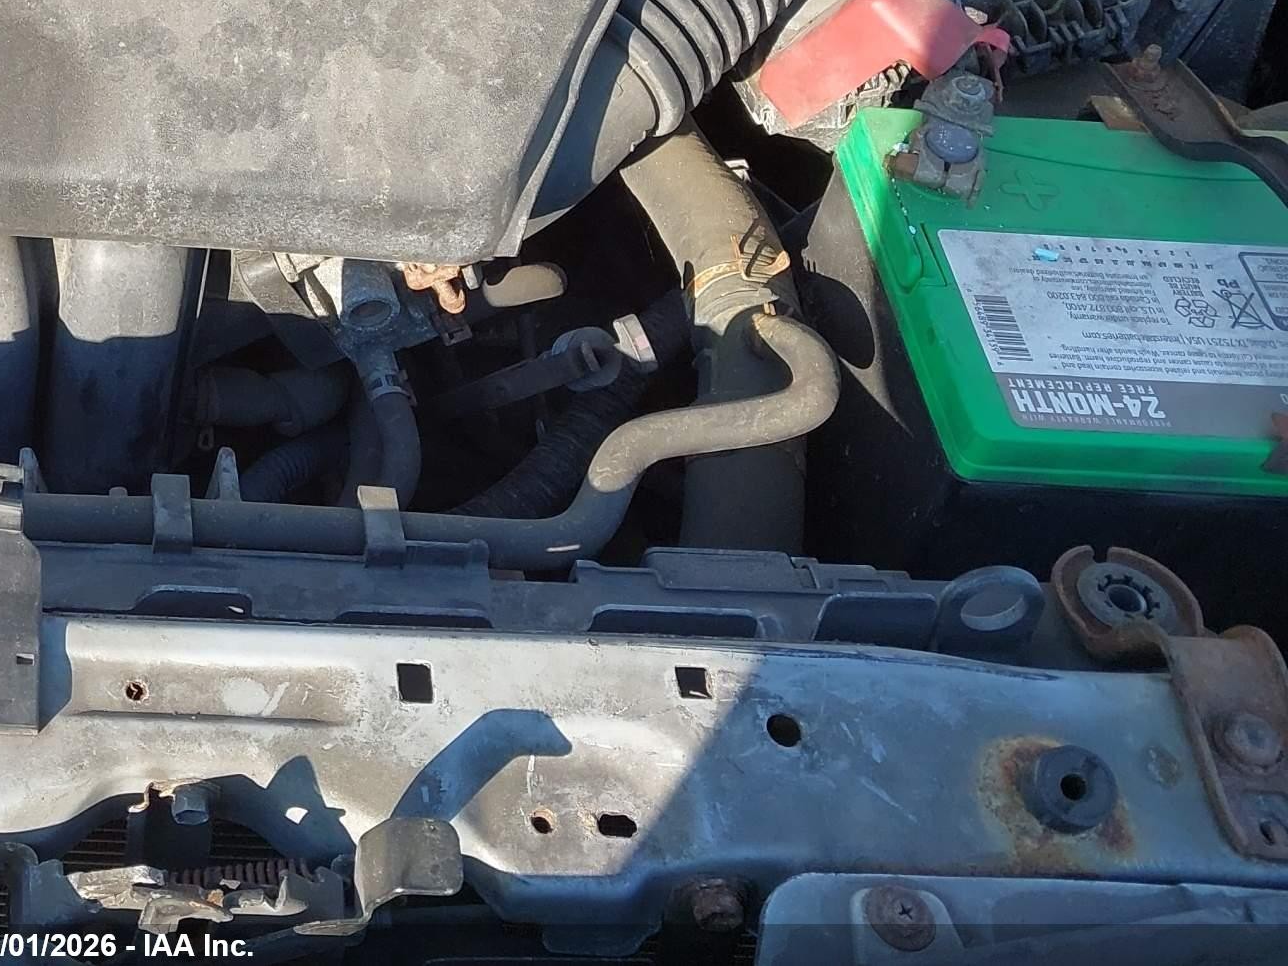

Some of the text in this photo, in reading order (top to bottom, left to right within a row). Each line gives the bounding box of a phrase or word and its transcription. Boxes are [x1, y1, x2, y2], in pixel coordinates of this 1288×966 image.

[1162, 276, 1201, 284] RECYCLED
[1217, 279, 1240, 289] Pb
[1172, 289, 1205, 297] BATTERY
[1160, 317, 1171, 325] To
[1185, 336, 1204, 345] USA
[1206, 337, 1234, 346] 75251
[1049, 353, 1081, 362] Batteries
[1062, 361, 1077, 370] and
[1078, 362, 1093, 371] lead
[1093, 363, 1122, 372] contain
[1166, 367, 1190, 375] related
[1192, 368, 1206, 376] and
[1007, 377, 1155, 395] FREE REPLACEMENT
[1010, 388, 1166, 419] 24-MONTH
